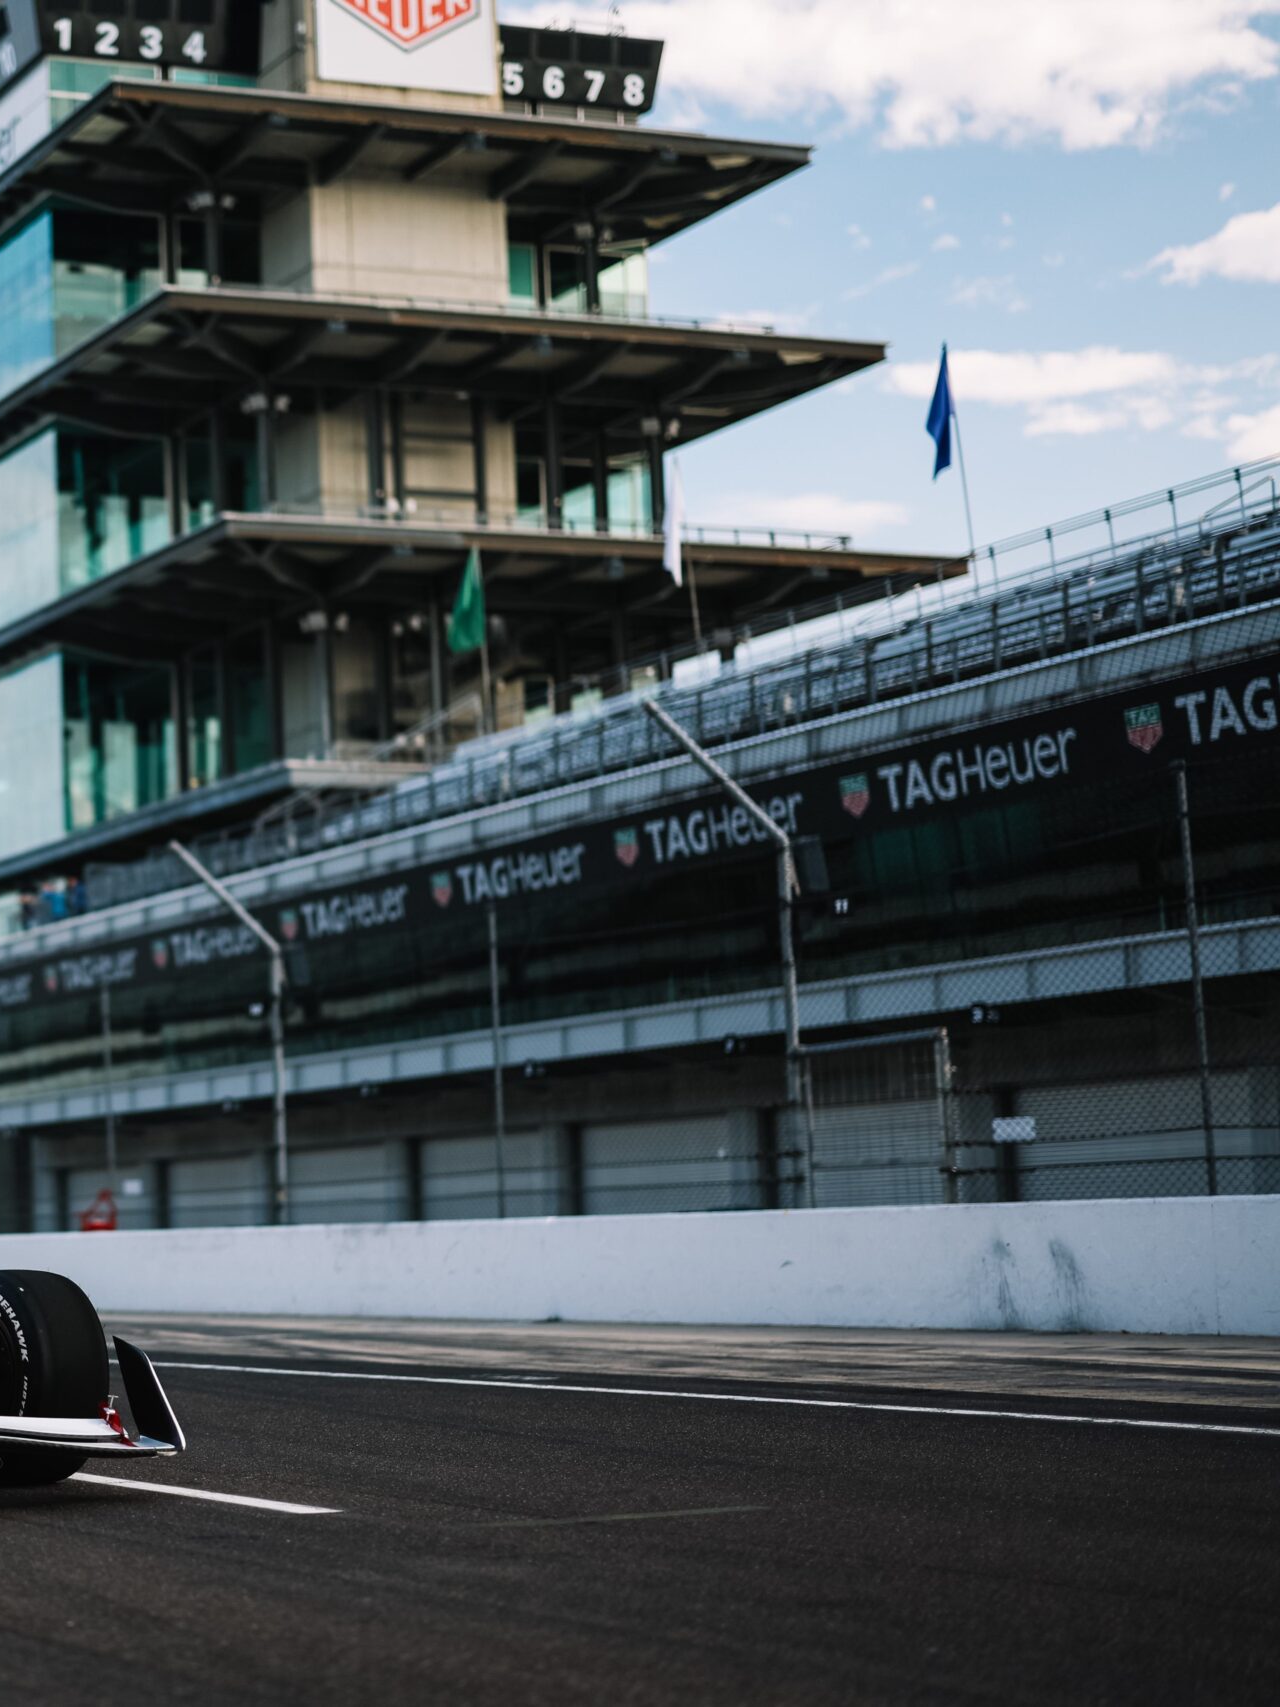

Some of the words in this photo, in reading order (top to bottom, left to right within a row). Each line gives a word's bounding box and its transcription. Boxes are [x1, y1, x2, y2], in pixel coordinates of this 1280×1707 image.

[53, 17, 72, 51] 1
[94, 21, 119, 55] 2
[138, 25, 163, 59] 3
[182, 30, 207, 64] 4
[502, 61, 524, 95] 5
[542, 65, 565, 99] 6
[583, 70, 606, 102] 7
[623, 73, 645, 107] 8
[1174, 673, 1280, 745] TAG
[19, 1375, 29, 1417] INDY5
